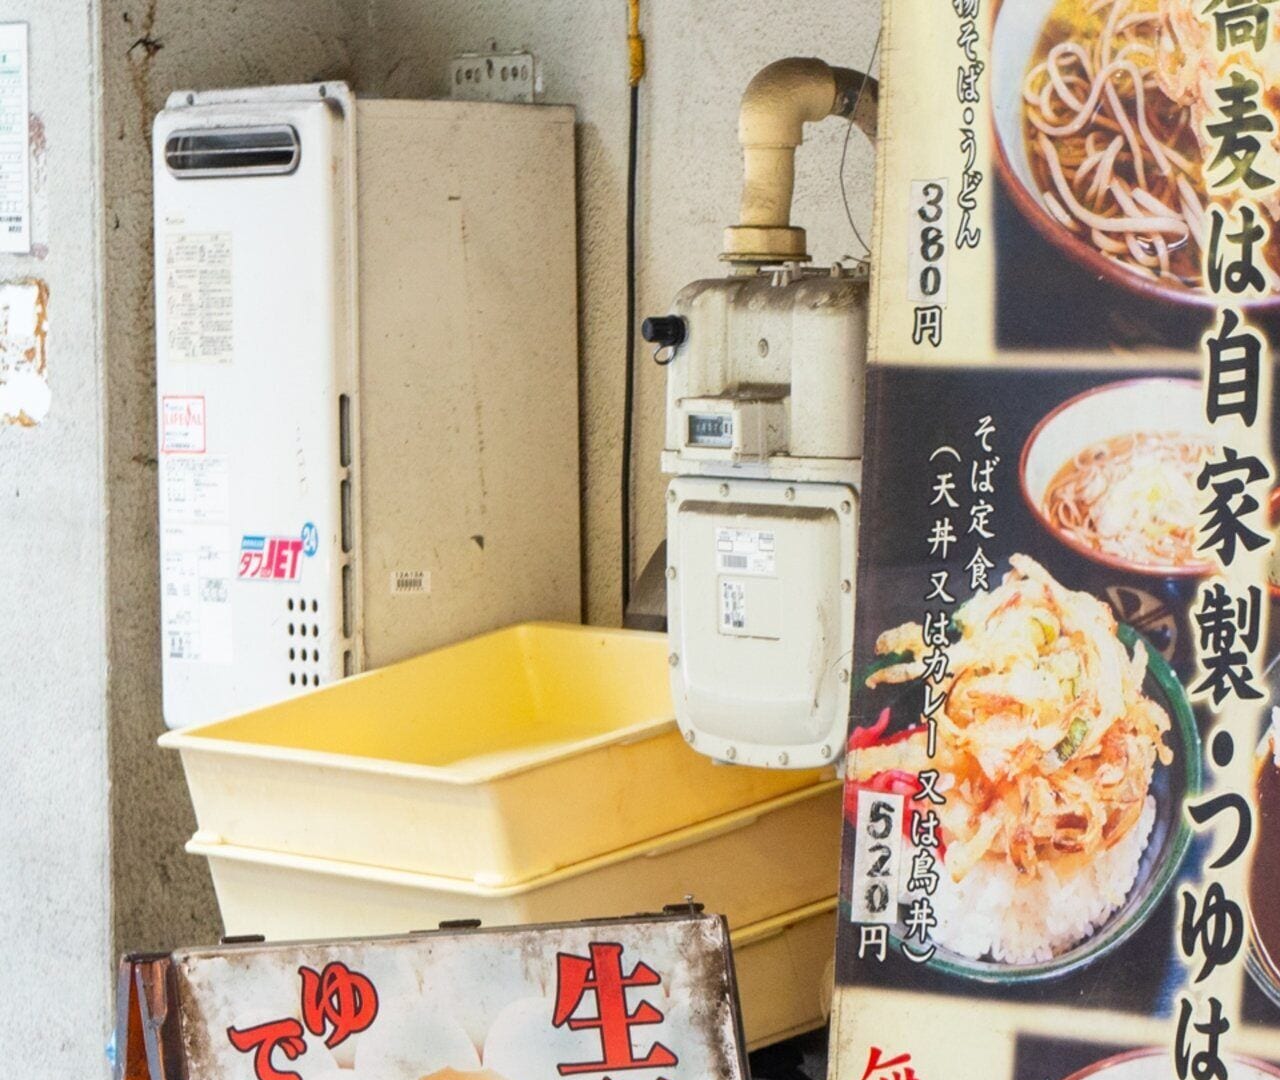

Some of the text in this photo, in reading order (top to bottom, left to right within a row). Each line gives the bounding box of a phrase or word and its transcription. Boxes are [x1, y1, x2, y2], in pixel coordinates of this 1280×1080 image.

[912, 182, 945, 347] 380円
[966, 414, 996, 591] そば定食
